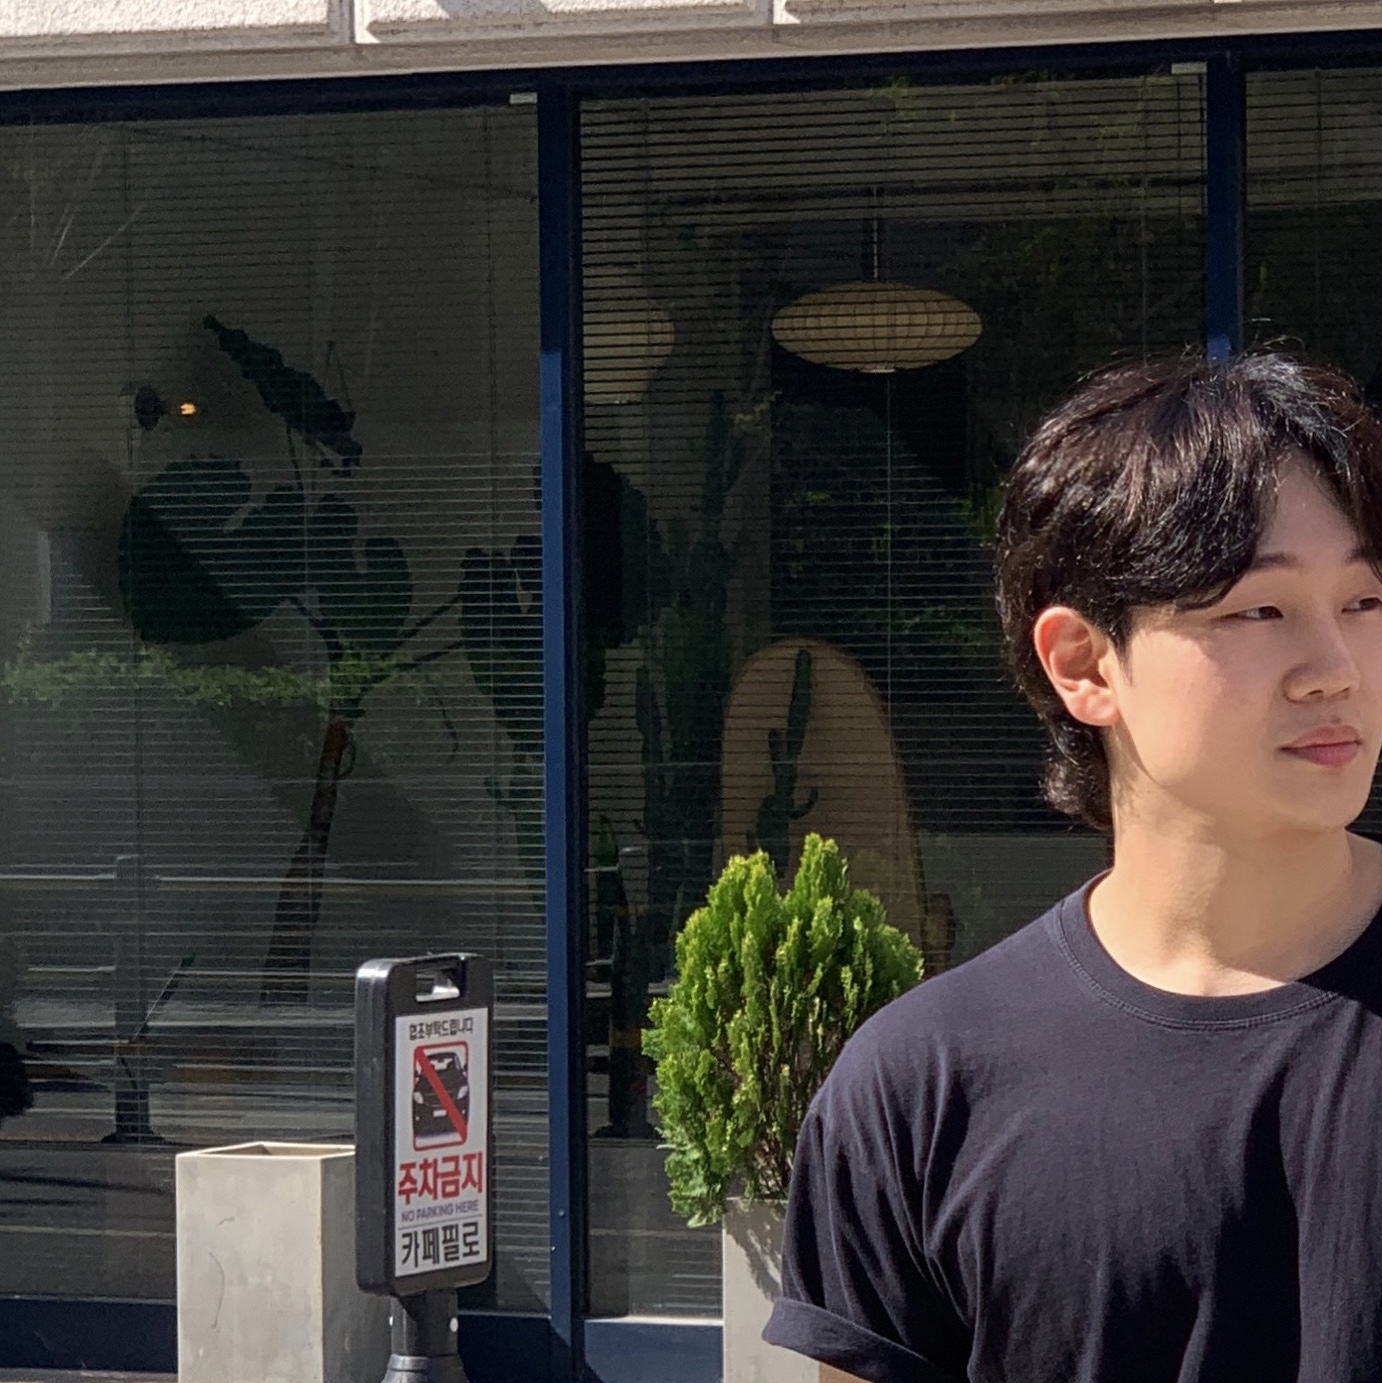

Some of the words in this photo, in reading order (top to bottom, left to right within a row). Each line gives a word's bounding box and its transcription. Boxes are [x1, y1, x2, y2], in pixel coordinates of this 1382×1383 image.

[398, 1152, 483, 1205] 주차금지
[401, 1210, 415, 1222] NO
[416, 1202, 454, 1219] PARKING
[455, 1199, 479, 1214] HERE
[401, 1221, 480, 1268] 카페필로
